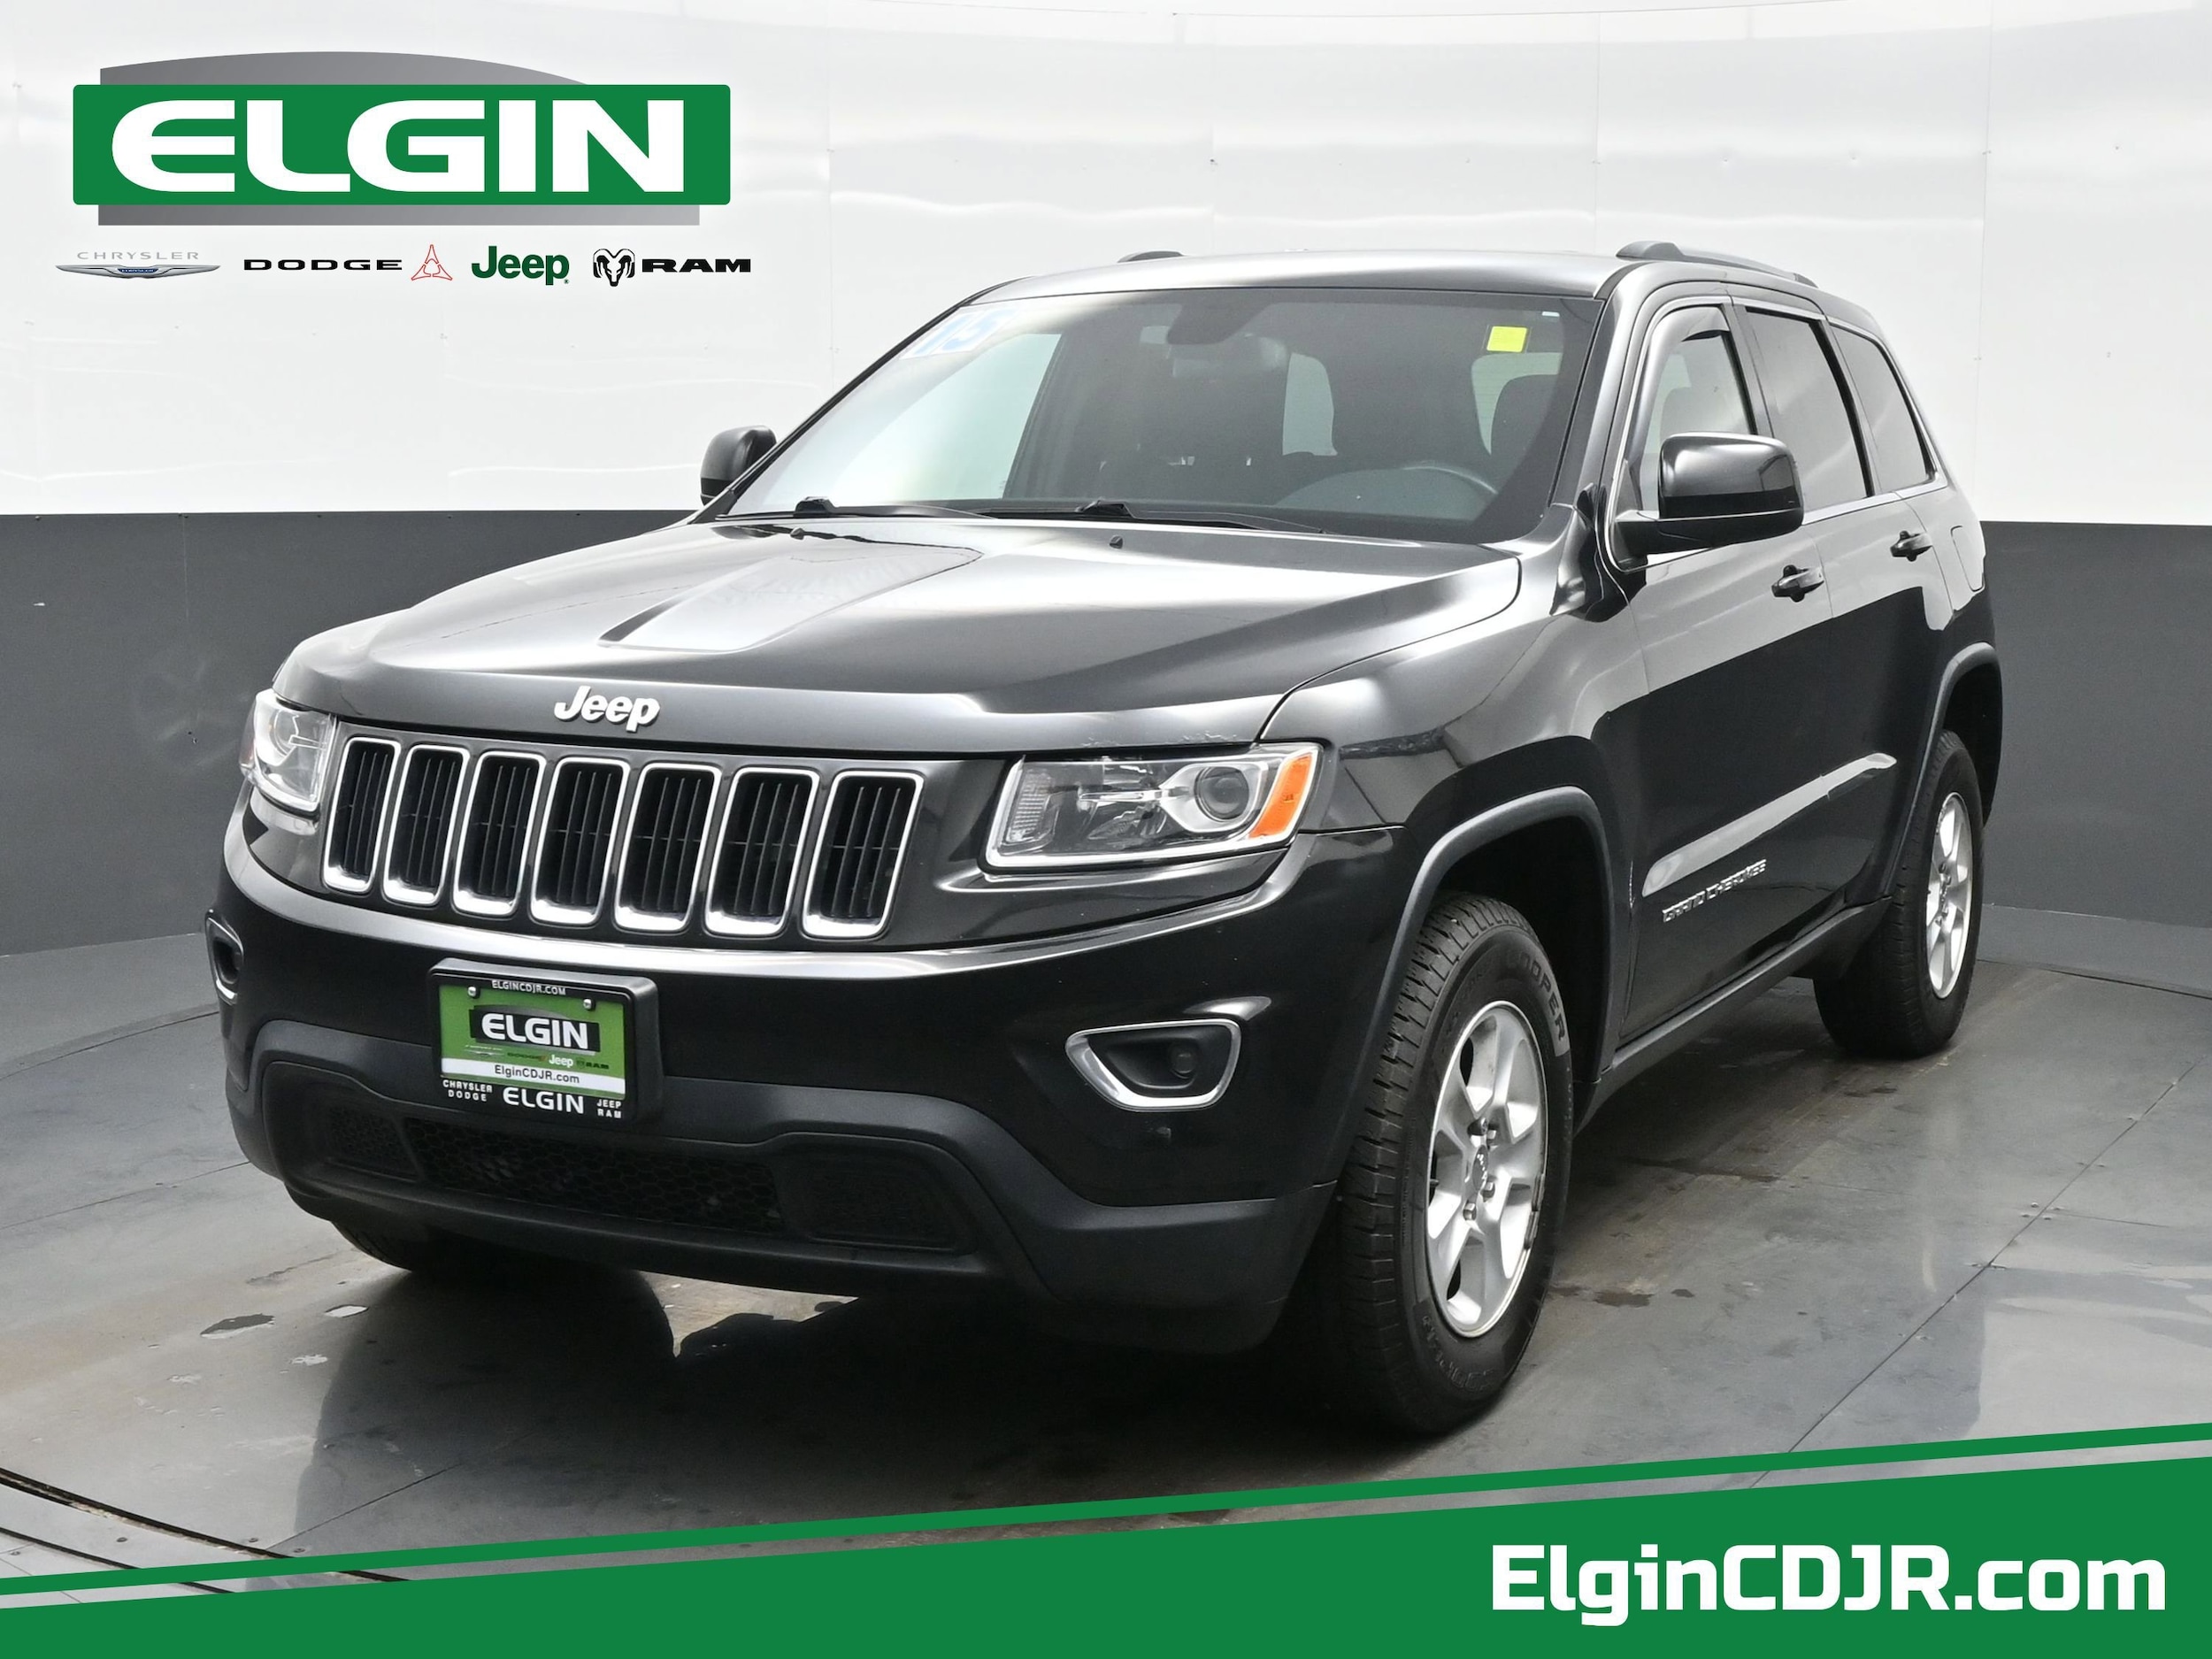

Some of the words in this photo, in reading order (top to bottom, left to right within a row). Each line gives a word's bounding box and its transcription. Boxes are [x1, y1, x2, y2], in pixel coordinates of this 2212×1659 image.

[554, 685, 661, 733] Jeep
[492, 980, 566, 995] ELGINCDJR.COM
[481, 1013, 588, 1049] ELGIN
[549, 1054, 574, 1069] Jeep
[495, 1065, 580, 1083] ElginCDJR.com
[443, 1079, 493, 1093] CHRYSLER
[448, 1089, 487, 1102] DODGE
[503, 1087, 584, 1114] ELGIN
[596, 1099, 622, 1110] JEEP
[597, 1108, 622, 1119] RAM
